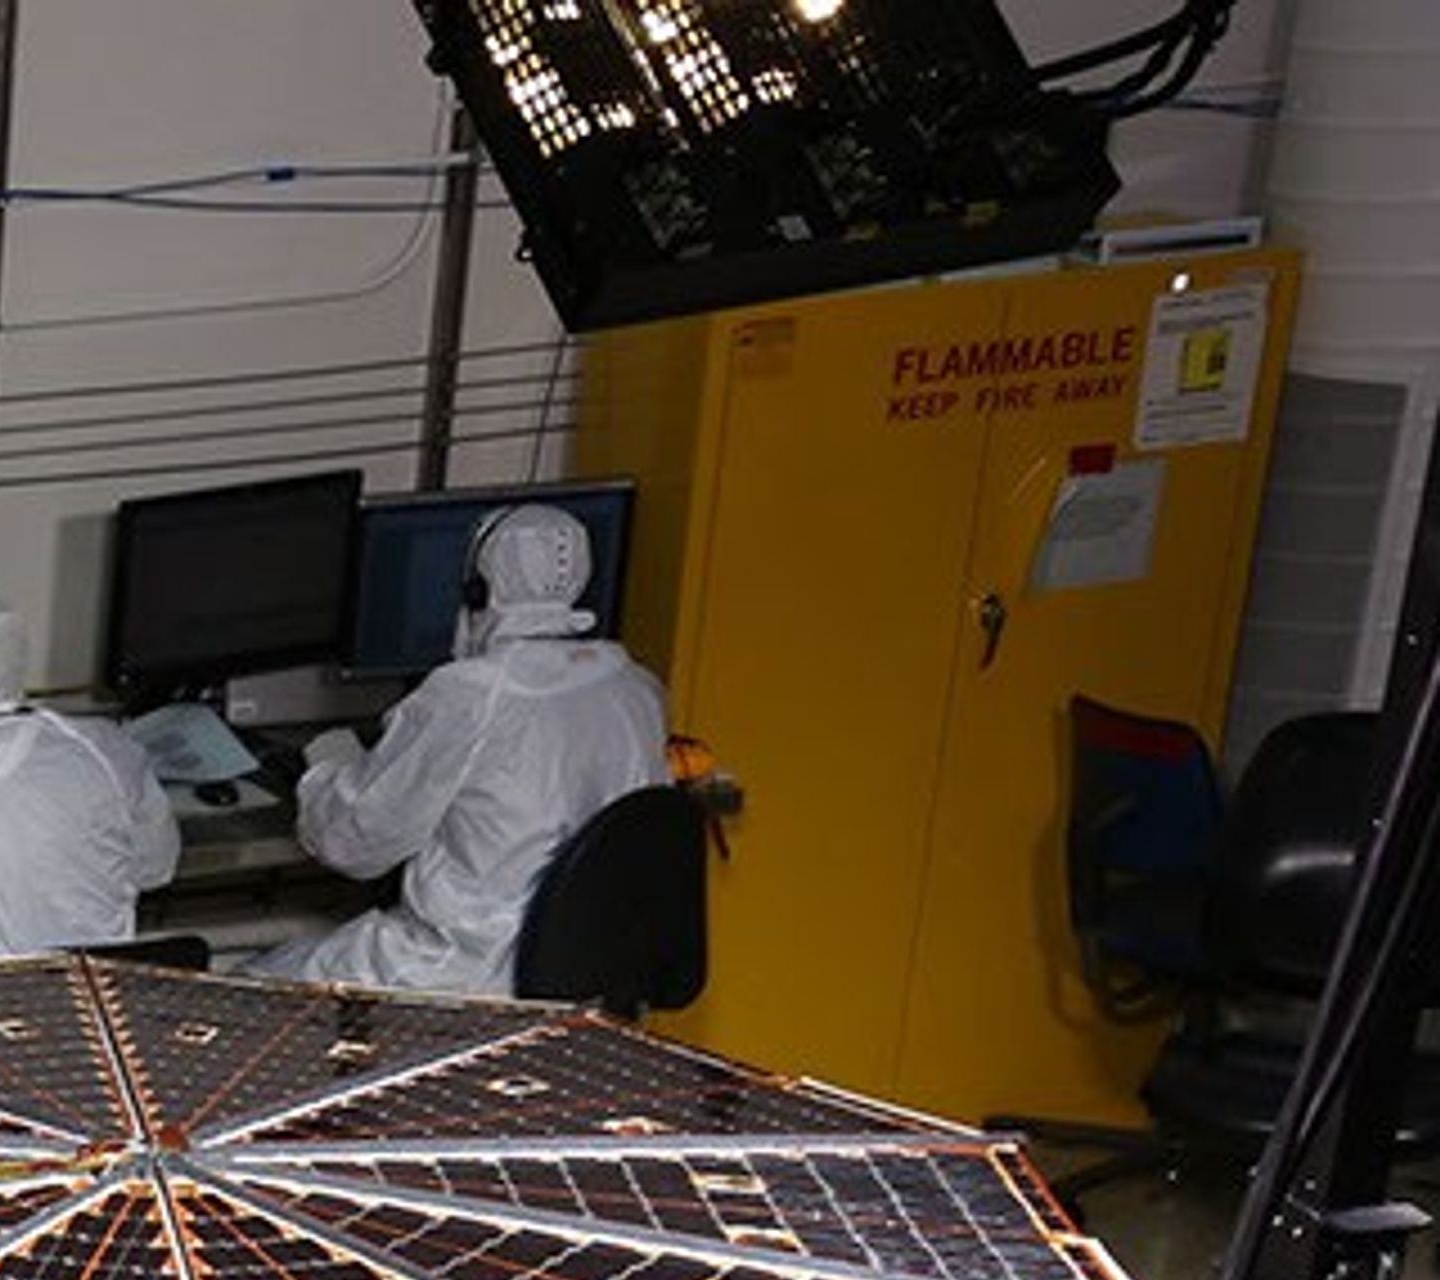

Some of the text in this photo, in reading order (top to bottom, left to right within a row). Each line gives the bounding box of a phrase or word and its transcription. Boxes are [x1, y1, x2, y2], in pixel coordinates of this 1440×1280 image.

[893, 327, 1135, 385] FLAMMABLE
[887, 375, 1128, 420] KEEP FIRE AWAY
